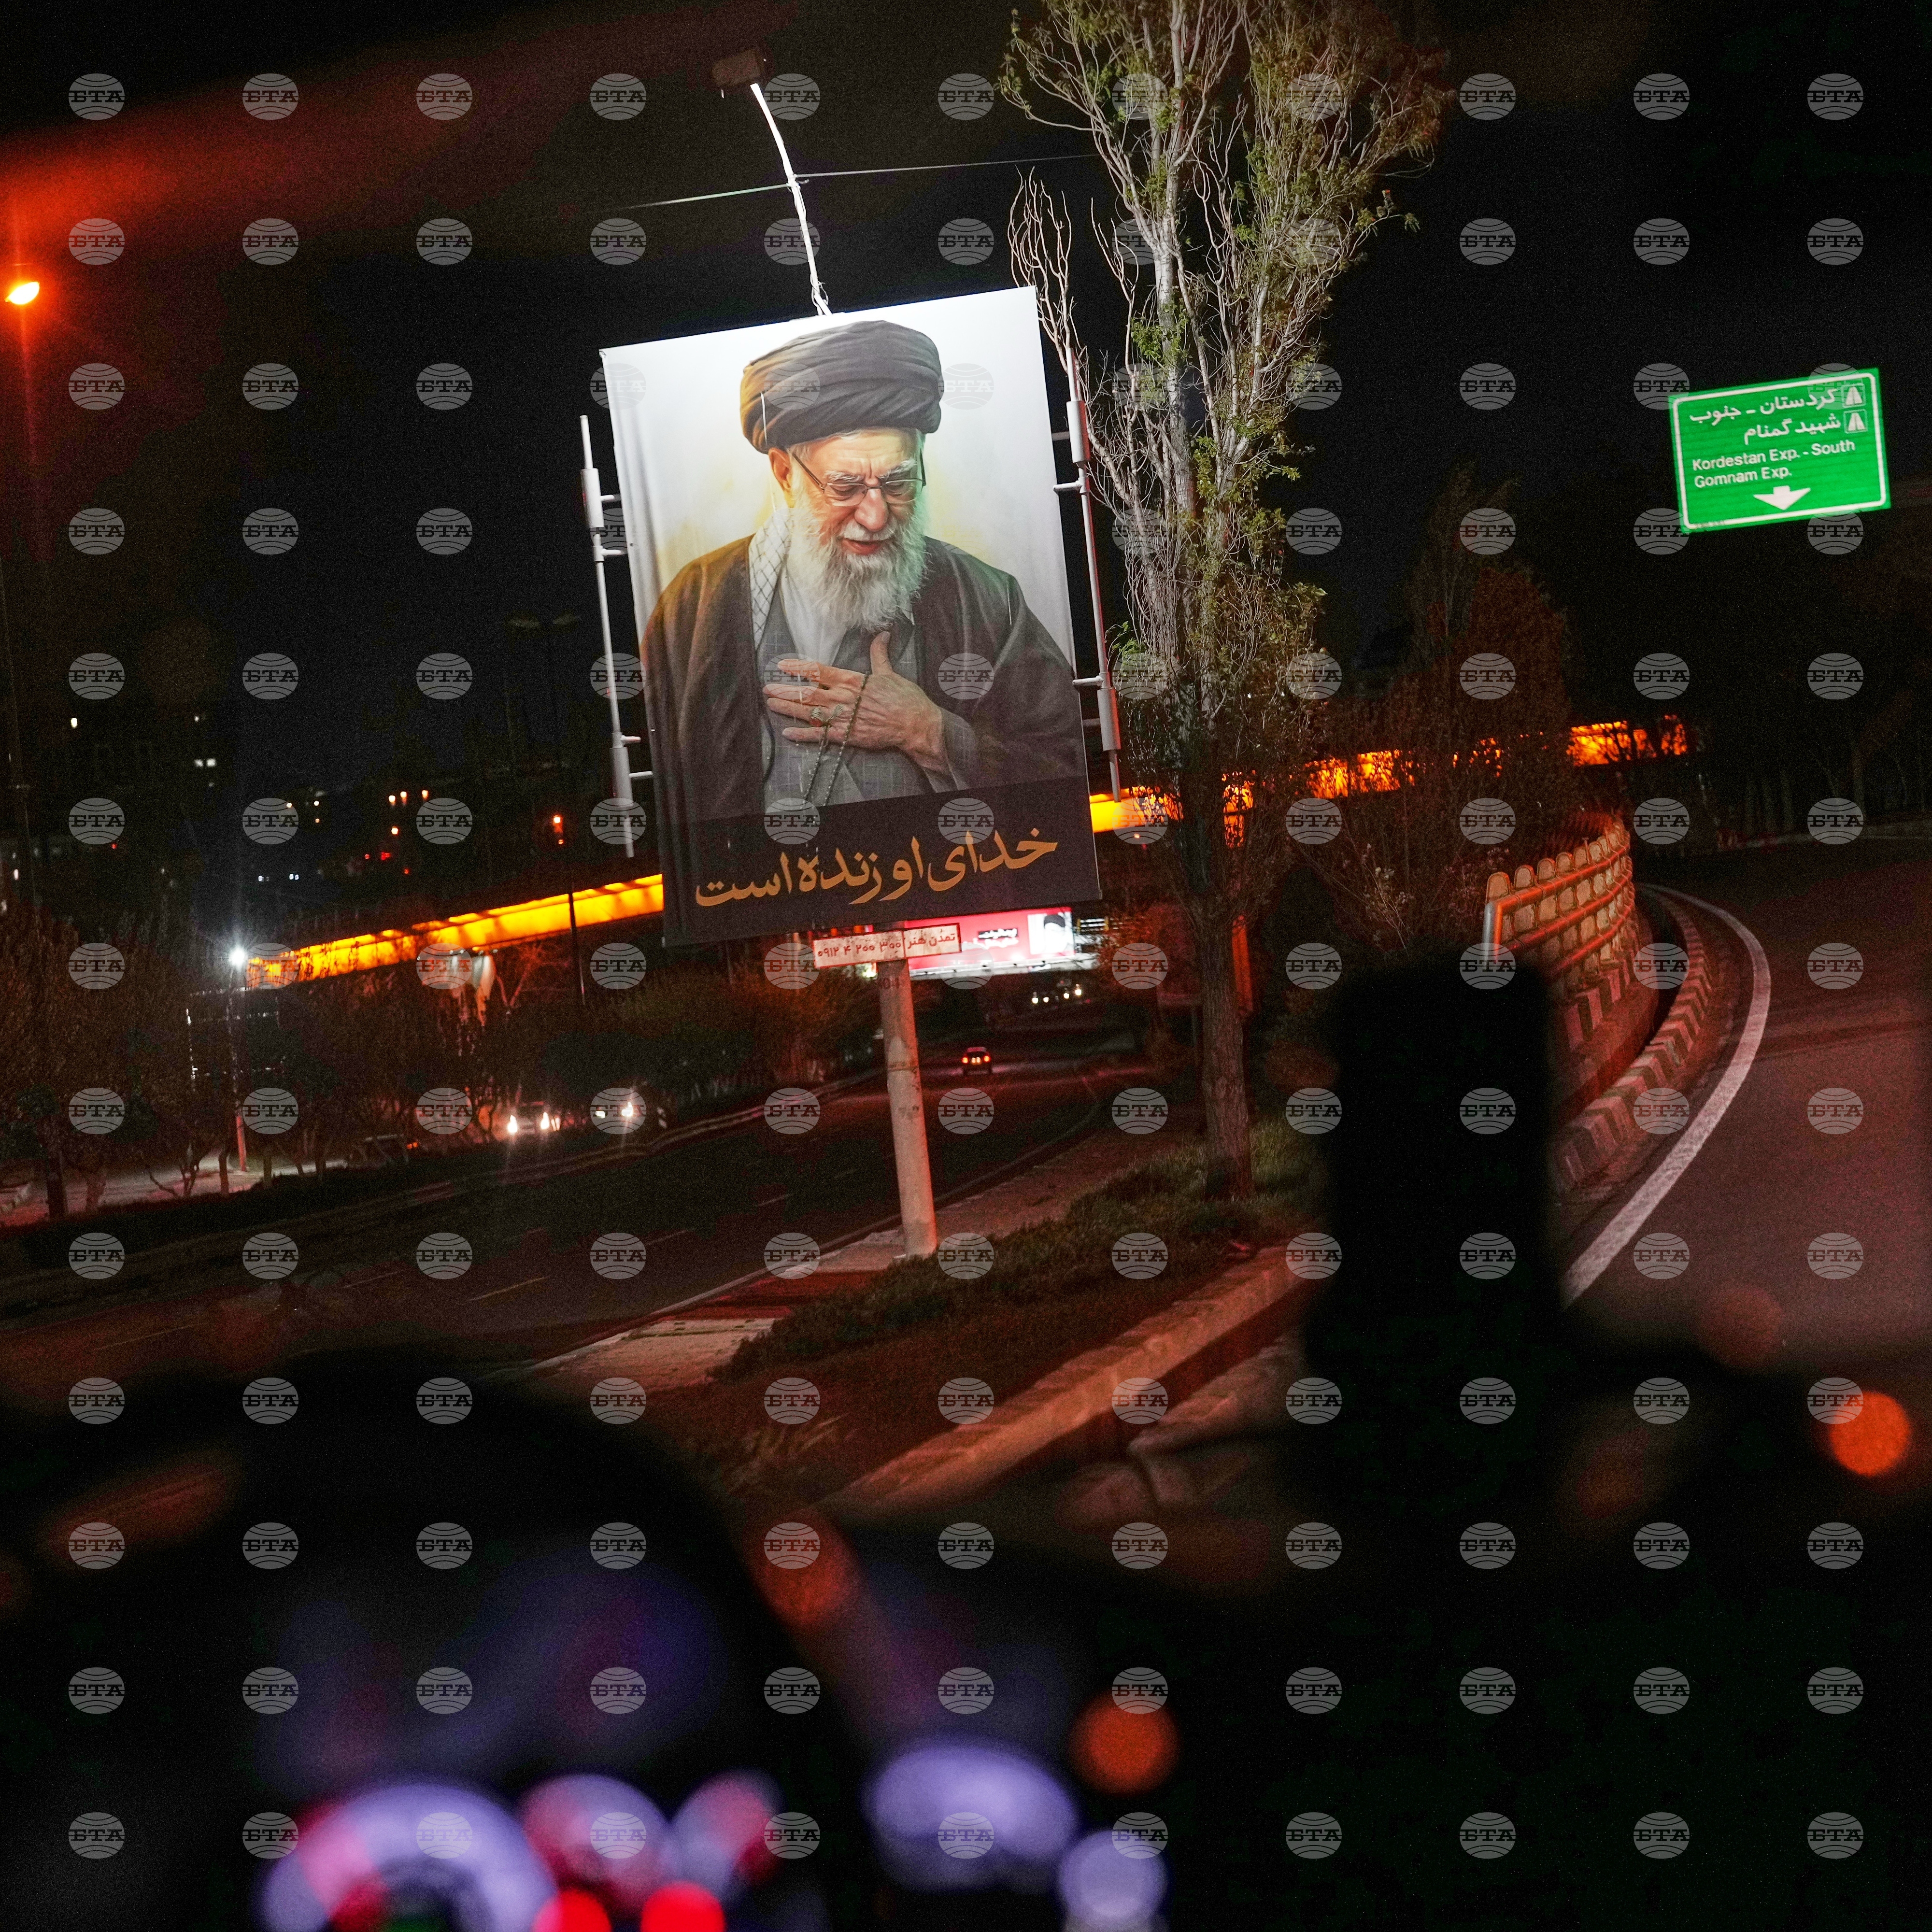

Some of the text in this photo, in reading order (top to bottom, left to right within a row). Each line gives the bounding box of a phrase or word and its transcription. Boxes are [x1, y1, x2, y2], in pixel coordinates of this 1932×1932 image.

[1760, 388, 1838, 415] کردستان
[1689, 405, 1742, 426] جنوب
[1744, 413, 1841, 445] شهید گمنام
[1692, 452, 1766, 471] Kordestan
[1769, 449, 1801, 461] Exp.
[1811, 440, 1856, 456] South
[1694, 467, 1792, 488] Gomnam Exp.
[696, 827, 1058, 907] خدای او زنده است
[907, 936, 926, 950] هنر
